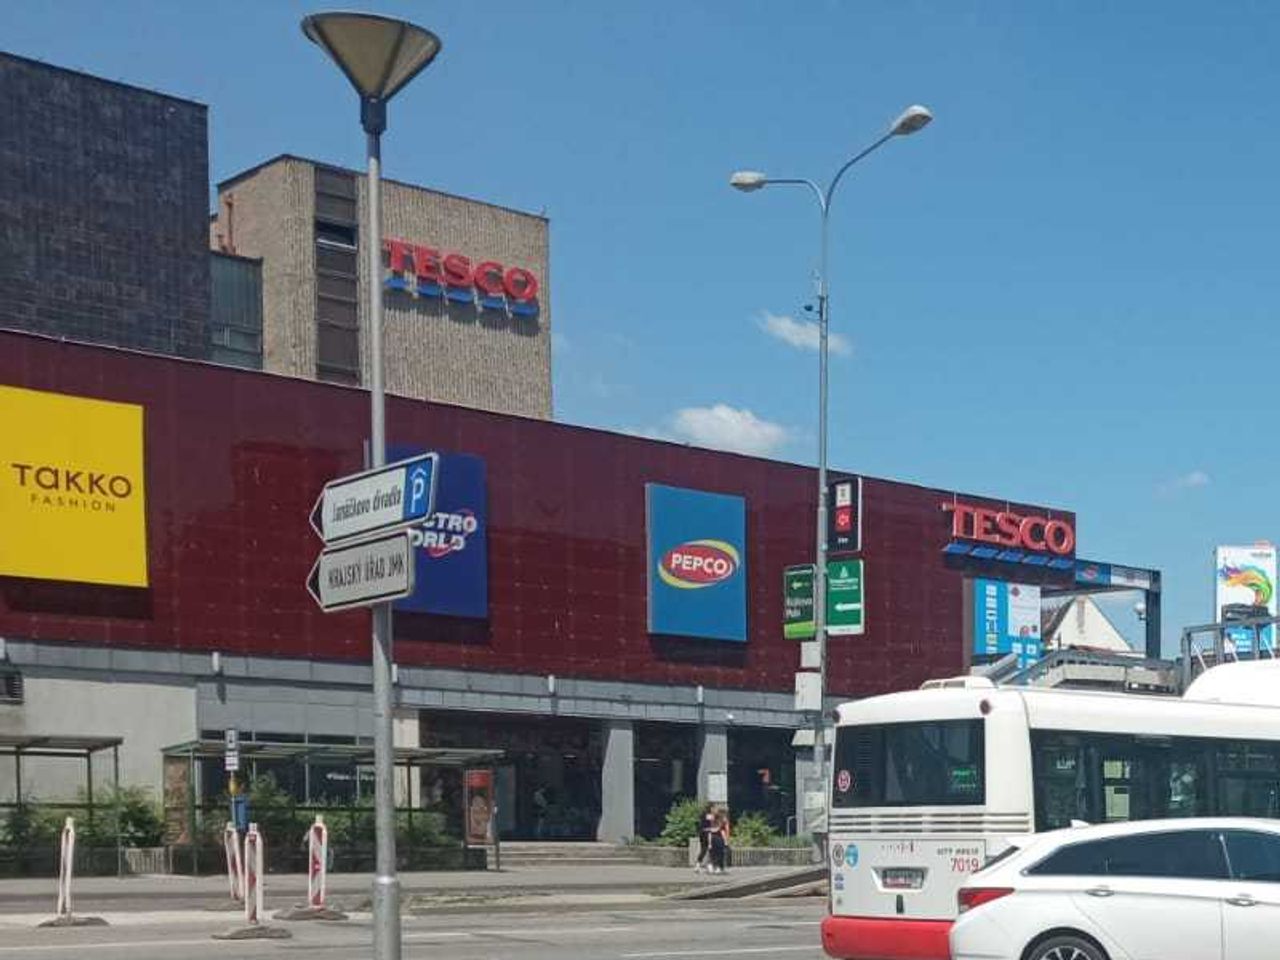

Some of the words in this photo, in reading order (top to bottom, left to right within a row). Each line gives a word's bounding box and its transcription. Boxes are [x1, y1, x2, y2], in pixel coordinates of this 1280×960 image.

[383, 238, 539, 300] TESCO
[30, 493, 115, 512] FASHION
[951, 504, 1075, 555] TESCO
[670, 553, 728, 575] PEPCO
[950, 857, 979, 871] 7019
